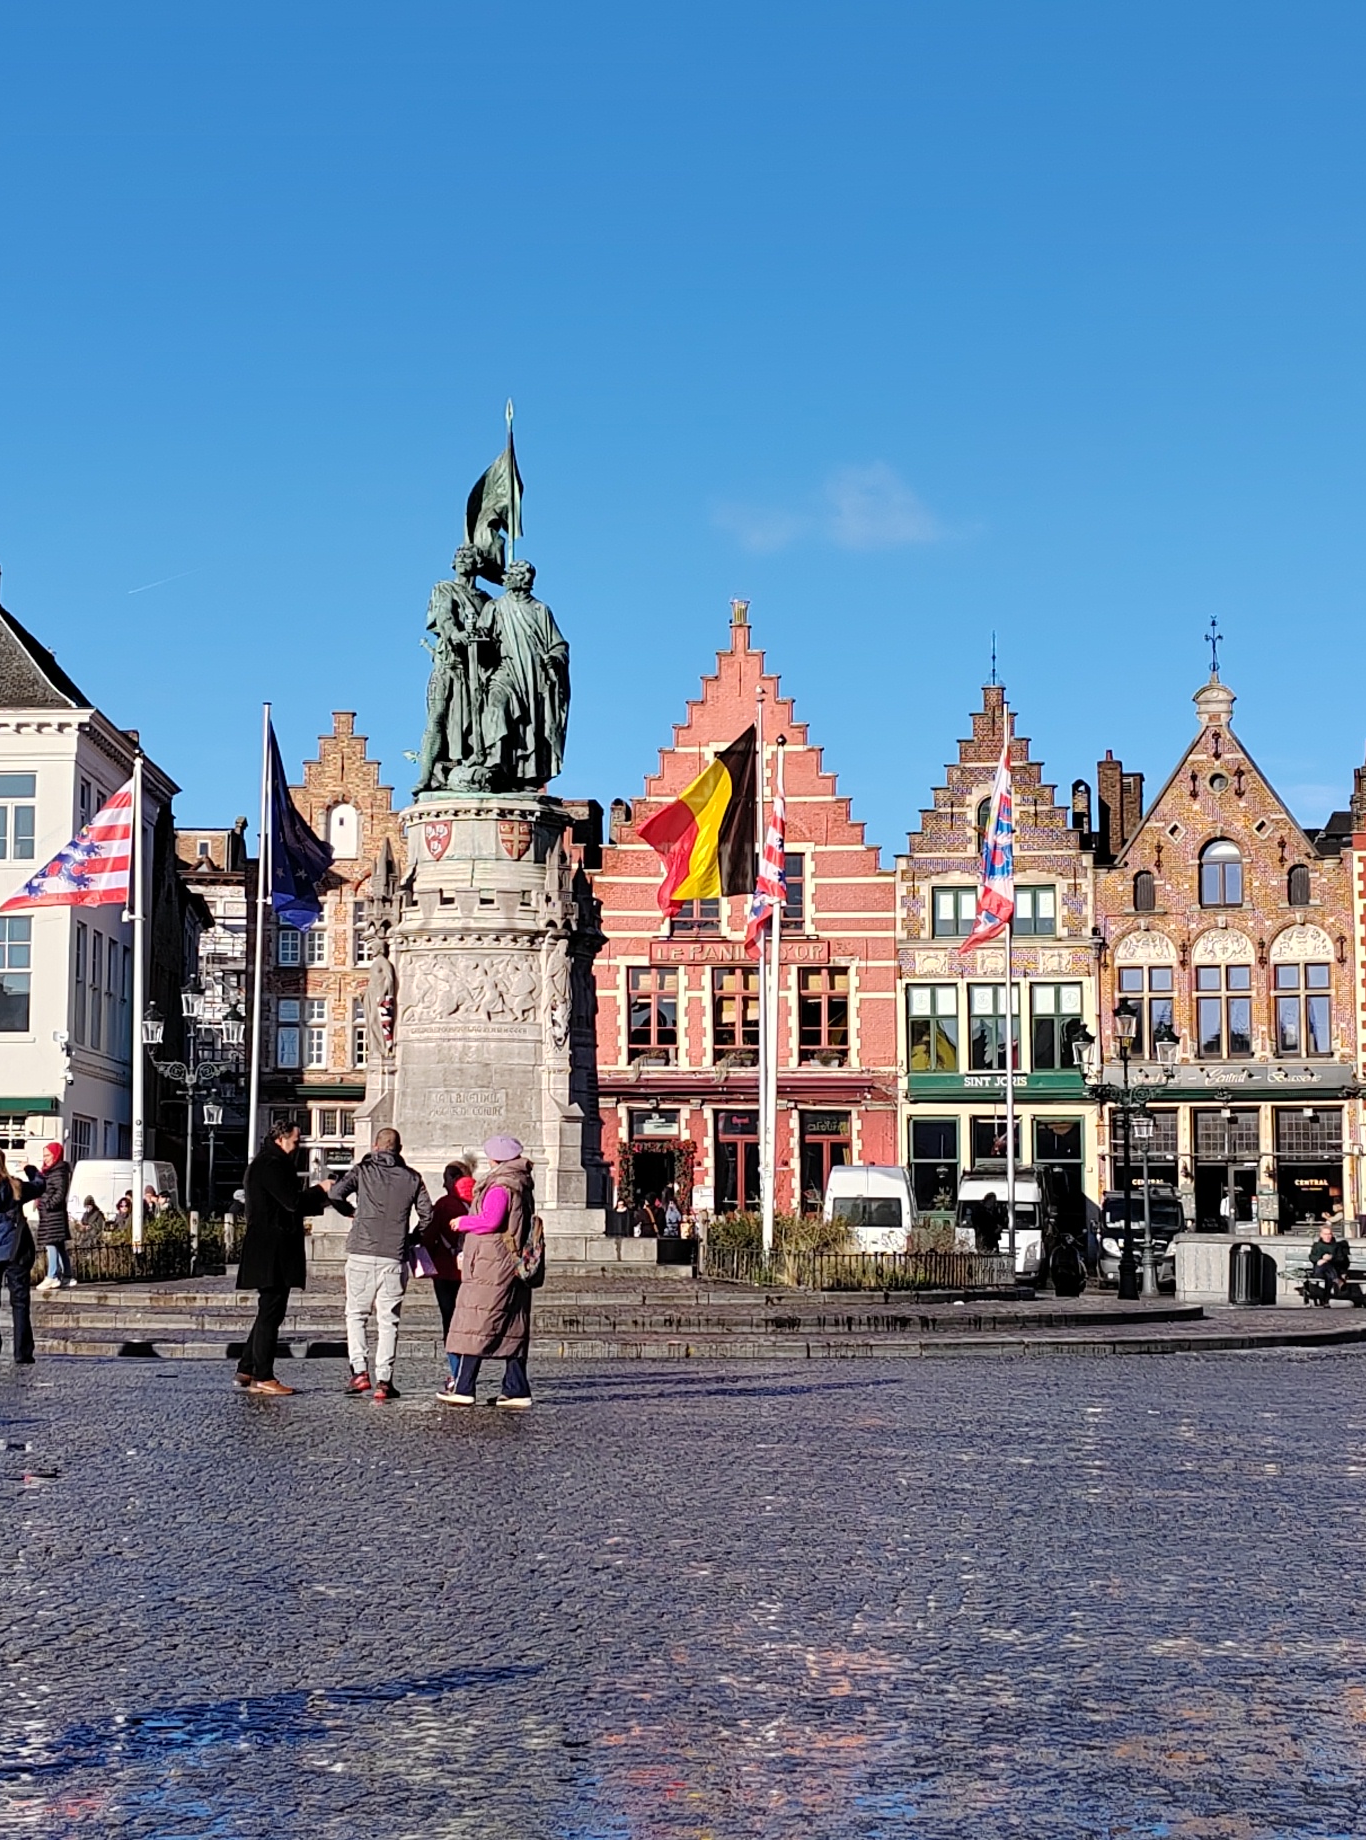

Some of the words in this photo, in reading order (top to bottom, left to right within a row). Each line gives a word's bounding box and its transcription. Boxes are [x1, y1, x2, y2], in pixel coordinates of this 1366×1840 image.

[656, 947, 685, 961] LE
[963, 1076, 991, 1088] SINT
[1205, 1068, 1247, 1087] Central
